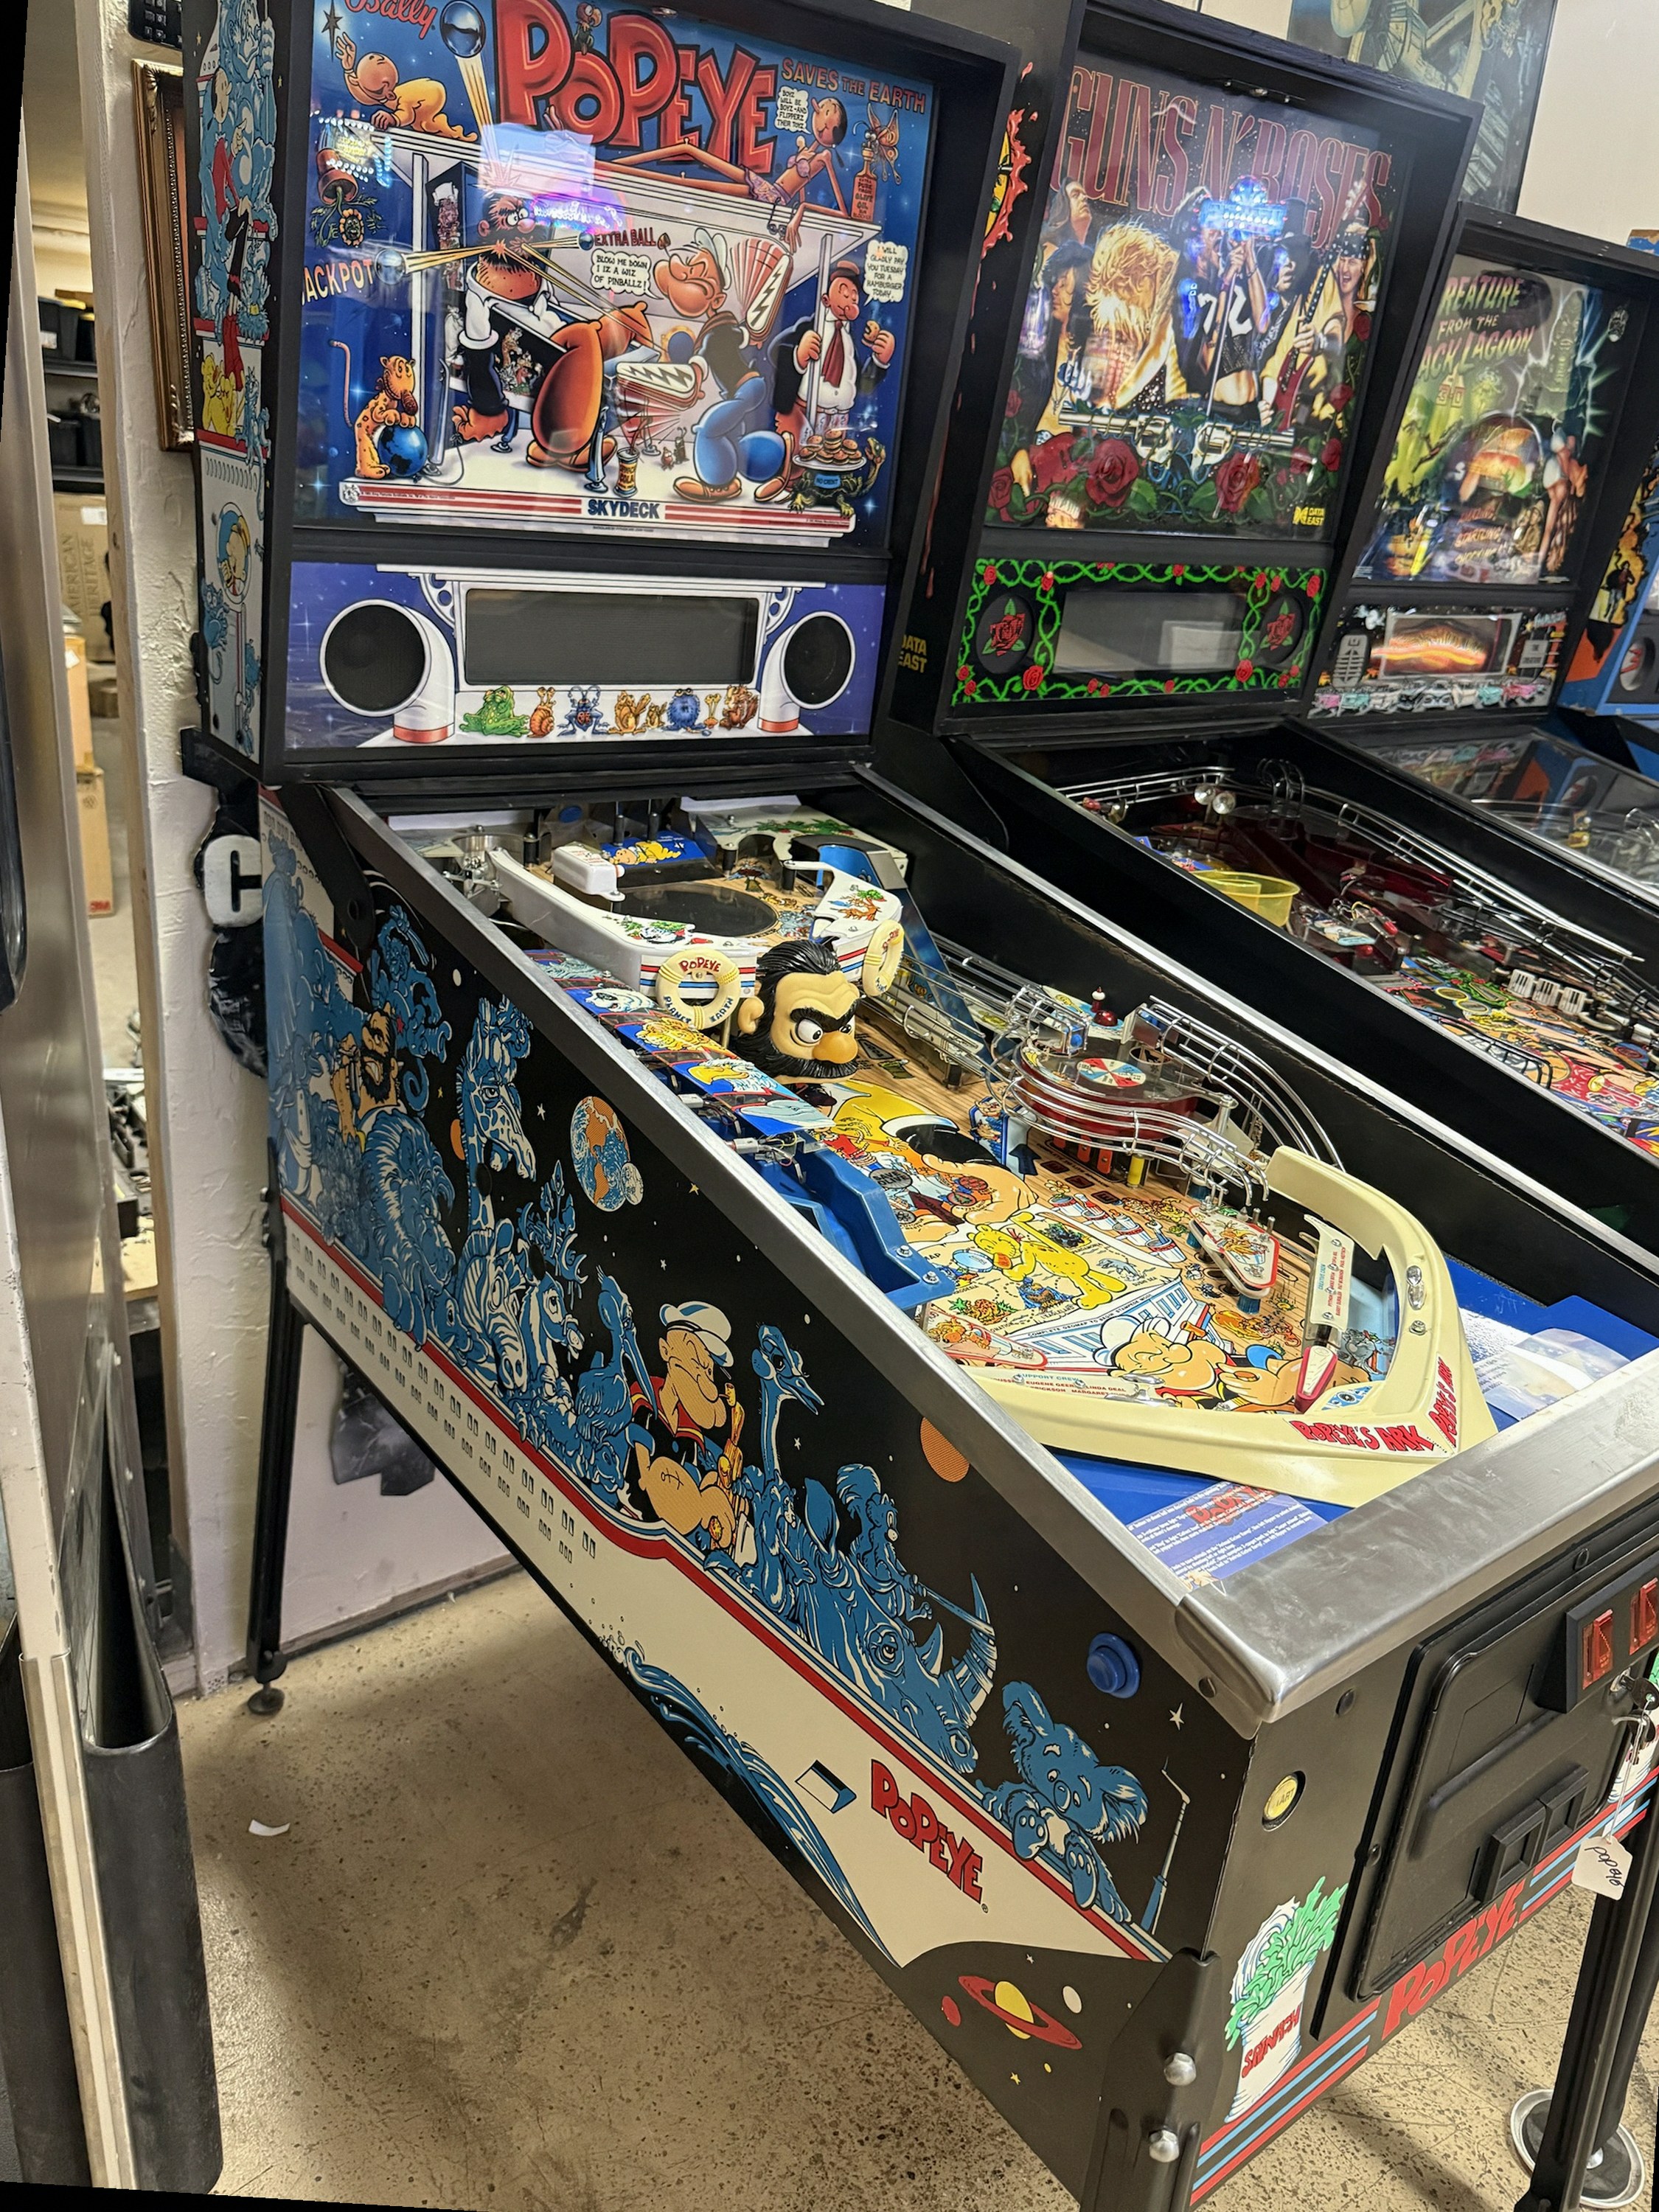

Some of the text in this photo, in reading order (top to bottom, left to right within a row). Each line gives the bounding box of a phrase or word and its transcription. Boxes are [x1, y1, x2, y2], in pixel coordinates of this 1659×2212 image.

[493, 0, 778, 175] POPEYE
[782, 57, 927, 114] SAVES THE EARTH
[1049, 64, 1200, 217] GUNS
[1249, 116, 1394, 251] ROSES
[594, 226, 657, 247] EXTRA BALL
[596, 254, 648, 269] BLOW ME DOWN
[597, 265, 599, 273] I
[613, 267, 619, 275] A
[622, 268, 636, 277] WIZ
[867, 262, 904, 276] YOU TUESDAY
[870, 254, 905, 265] GLADLY PAY
[301, 259, 374, 306] ACKPOT
[594, 275, 605, 283] OF
[866, 279, 902, 291] HAMBURGER
[1437, 274, 1525, 316] REATURE
[1437, 314, 1500, 341] FROM THE
[1416, 325, 1536, 383] ACK LAGOON
[587, 498, 661, 519] SKYDECK
[1308, 507, 1325, 517] DATA
[1306, 516, 1325, 526] EAST
[678, 956, 721, 973] POPEYE
[664, 995, 734, 1024] PLANET EARTH
[872, 1170, 900, 1181] SAVE
[877, 1174, 908, 1186] OLIVE
[1027, 1326, 1061, 1338] COMPLETE
[1099, 1312, 1115, 1322] BEGIN
[1116, 1300, 1140, 1314] STAMPEDE
[1021, 1372, 1054, 1380] UPPORT
[1427, 1356, 1458, 1448] POPEYE'S ARK
[1289, 1419, 1435, 1452] POPEYE'S ARK
[871, 1759, 984, 1905] POPEYE
[1381, 1877, 1526, 2042] POPEYE
[1241, 2000, 1304, 2079] SPINACH
